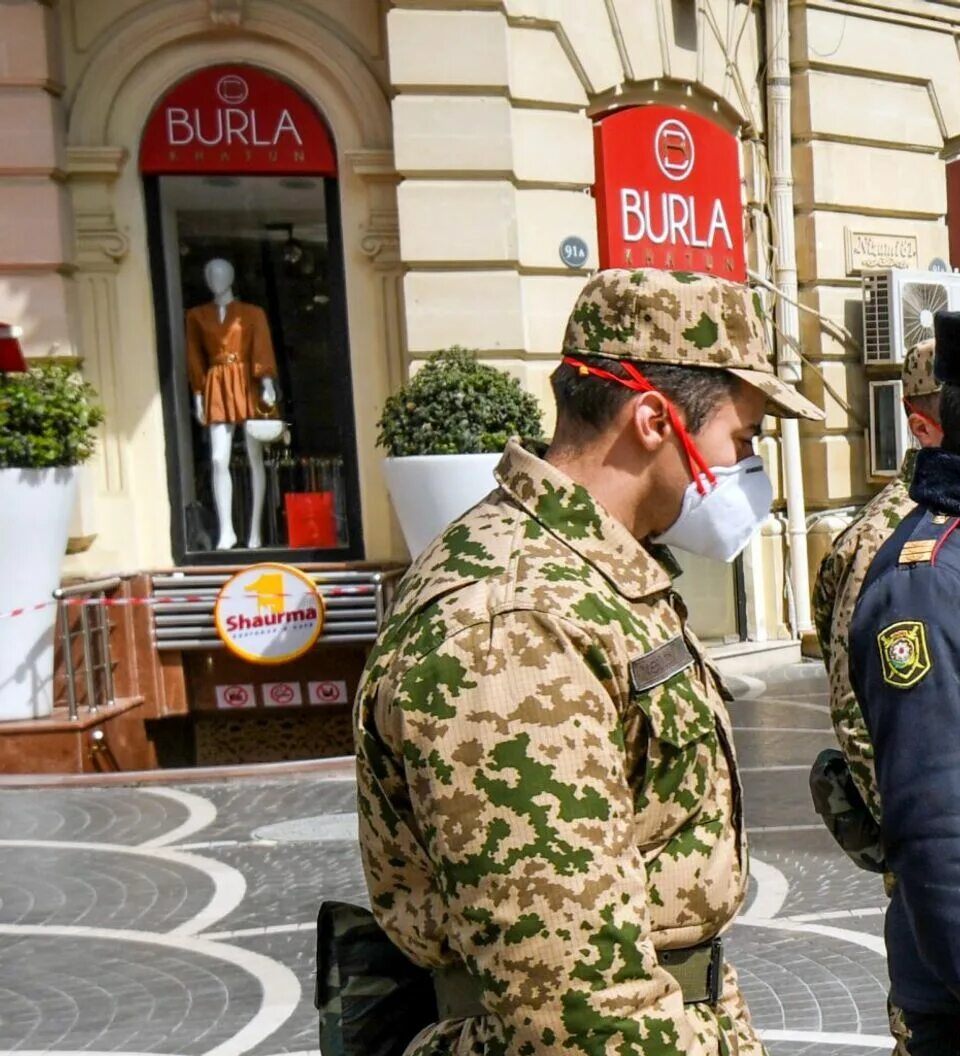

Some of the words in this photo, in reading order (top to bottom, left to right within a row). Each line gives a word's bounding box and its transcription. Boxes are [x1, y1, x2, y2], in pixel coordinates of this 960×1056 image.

[166, 107, 303, 146] BURLA
[620, 187, 734, 249] BURLA
[225, 607, 318, 632] Shaurma
